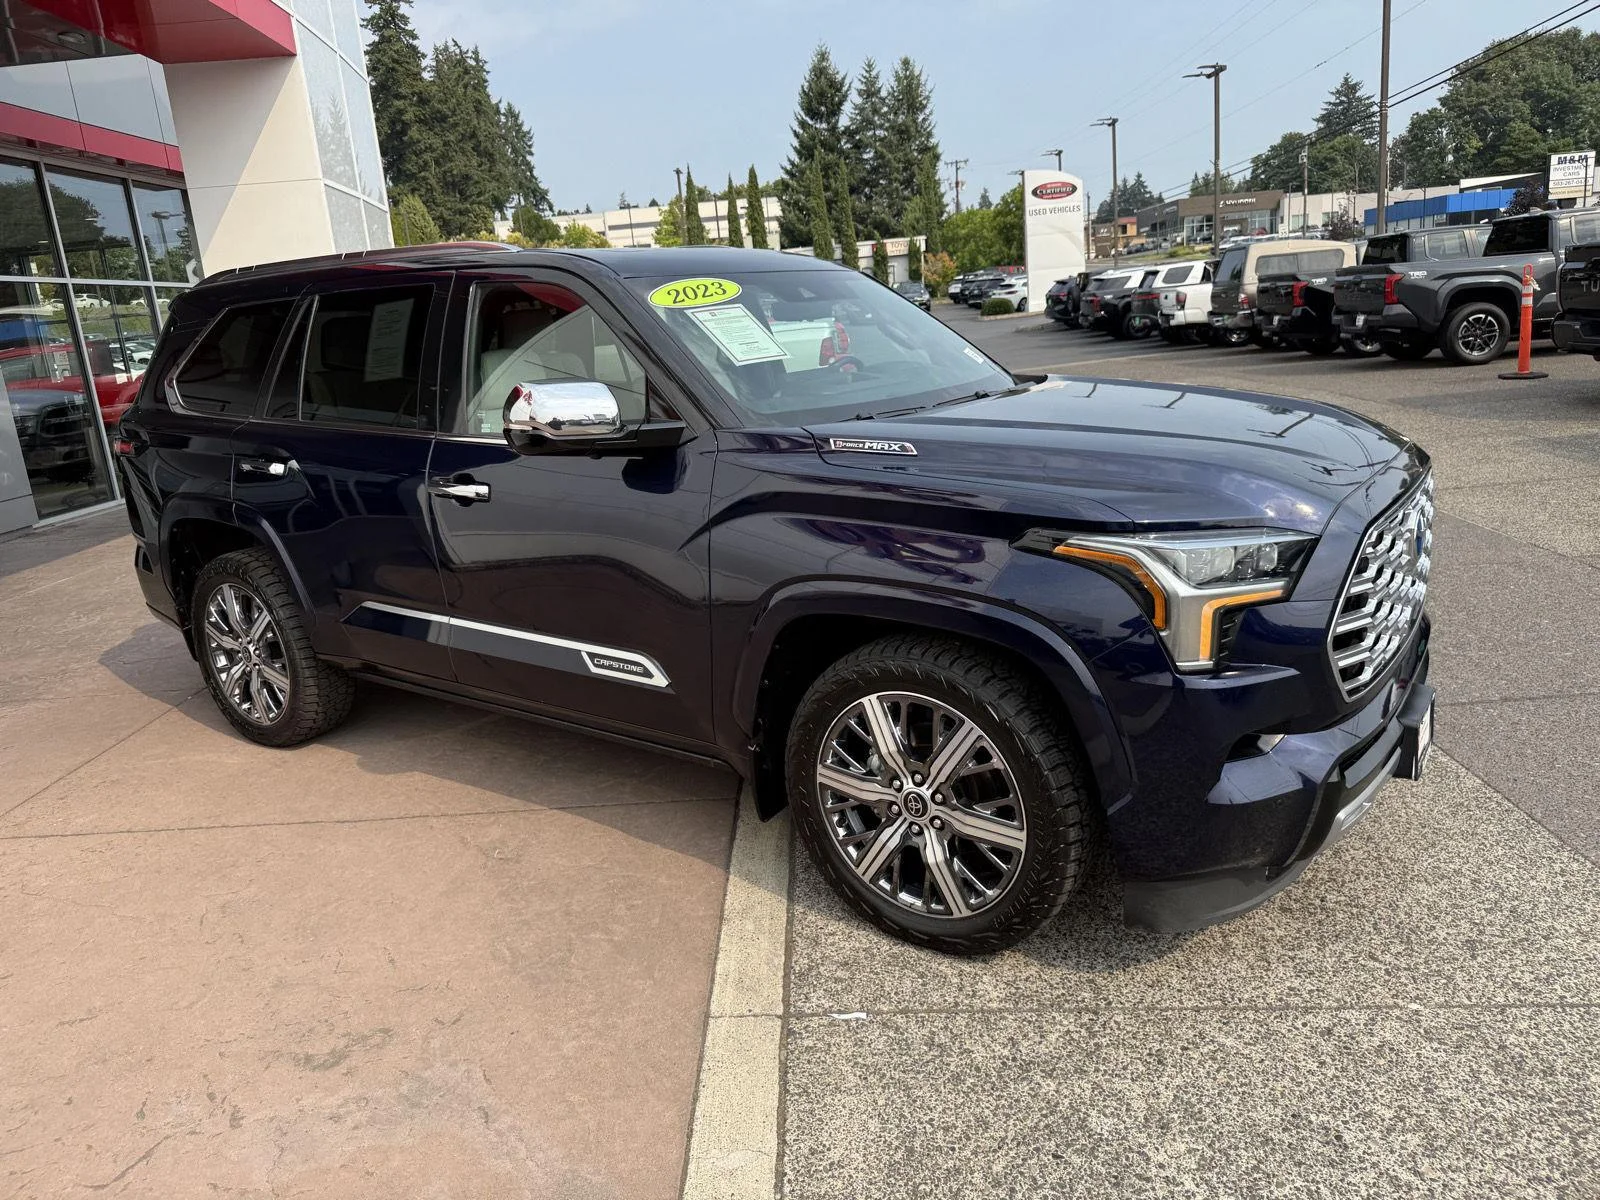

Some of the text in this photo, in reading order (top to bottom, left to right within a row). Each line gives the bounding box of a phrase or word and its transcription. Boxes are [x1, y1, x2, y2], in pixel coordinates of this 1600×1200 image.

[1036, 186, 1073, 195] CERTIFIED
[1028, 204, 1081, 217] USED VEHICLES
[666, 281, 727, 304] 2023
[864, 441, 902, 452] MAX
[594, 657, 644, 673] CAPSTONE
